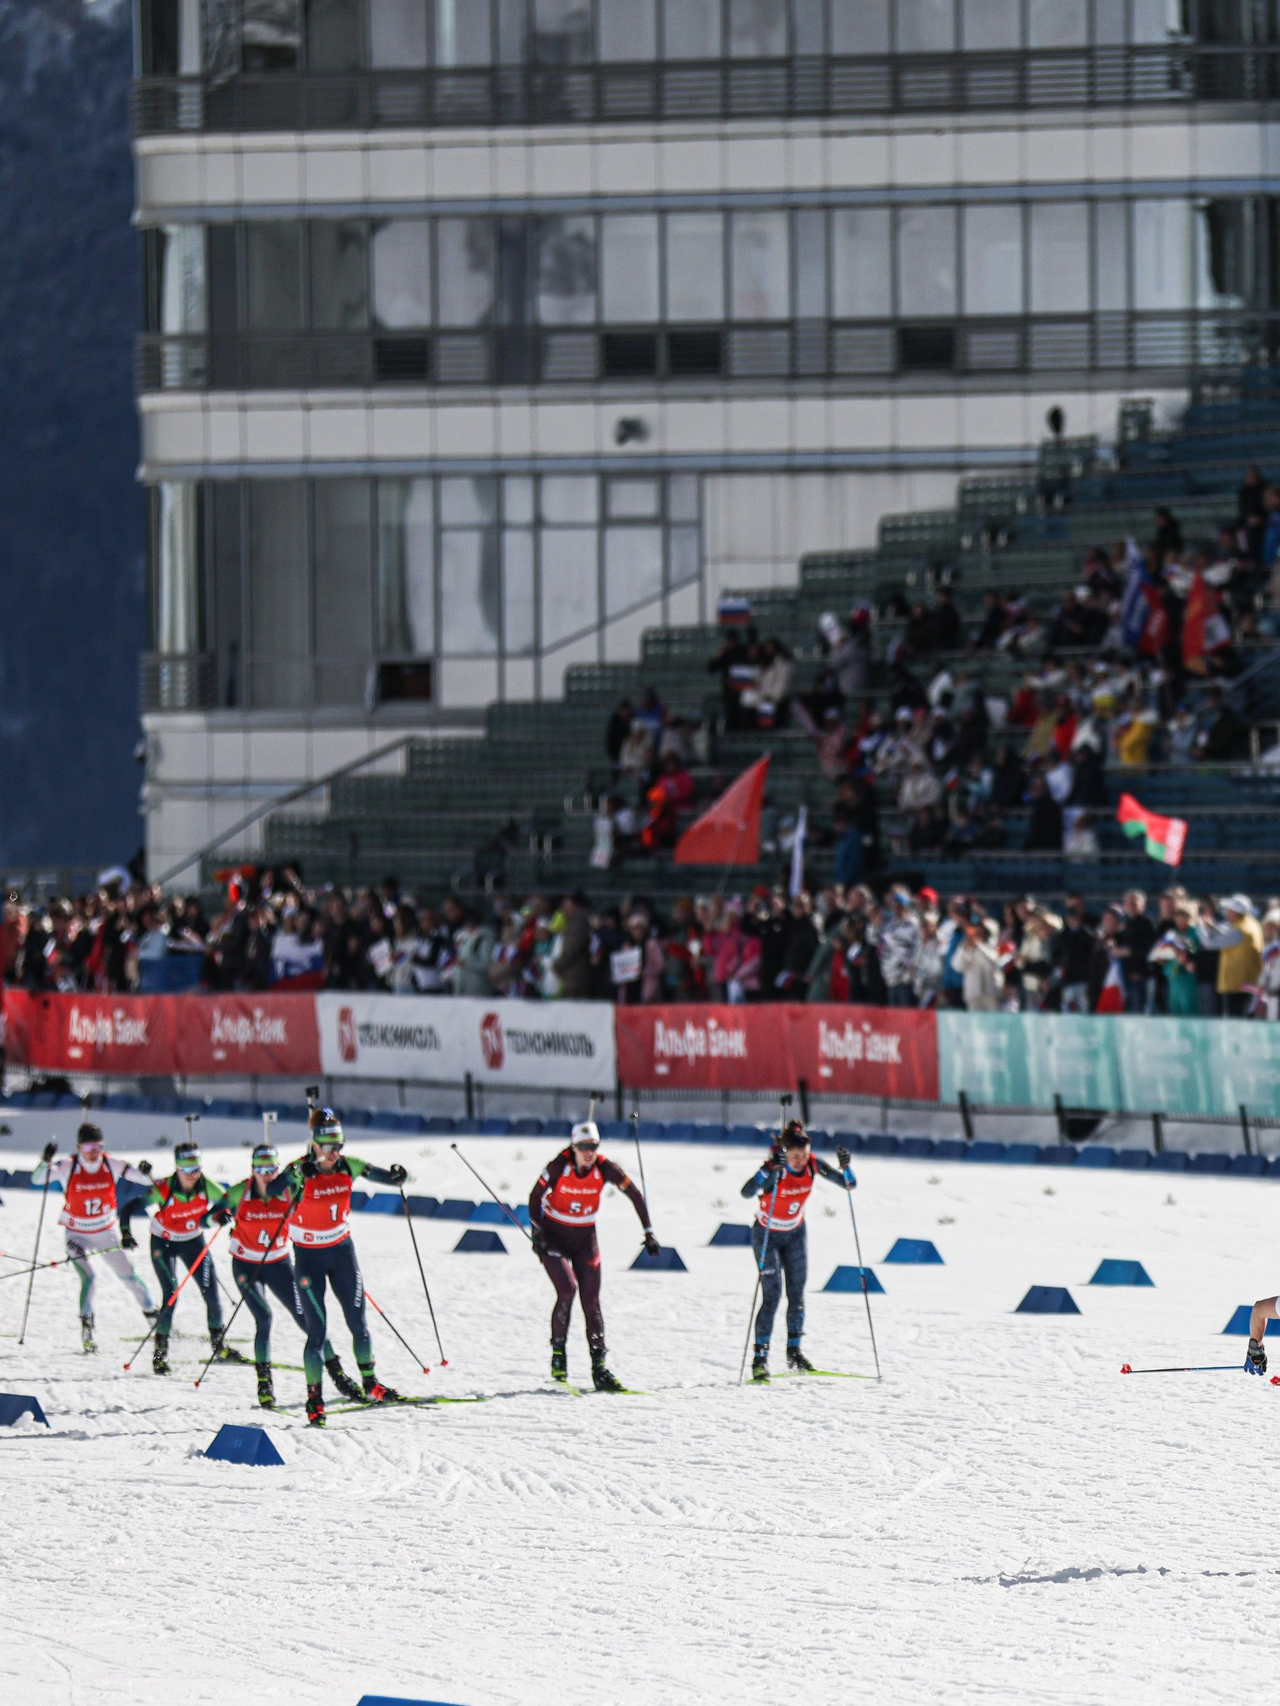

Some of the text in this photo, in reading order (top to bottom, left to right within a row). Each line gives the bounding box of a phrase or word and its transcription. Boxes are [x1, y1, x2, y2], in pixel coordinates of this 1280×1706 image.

[84, 1198, 102, 1215] 12
[330, 1203, 338, 1222] 1
[570, 1201, 582, 1213] 5
[787, 1201, 800, 1215] 9
[257, 1229, 271, 1248] 4
